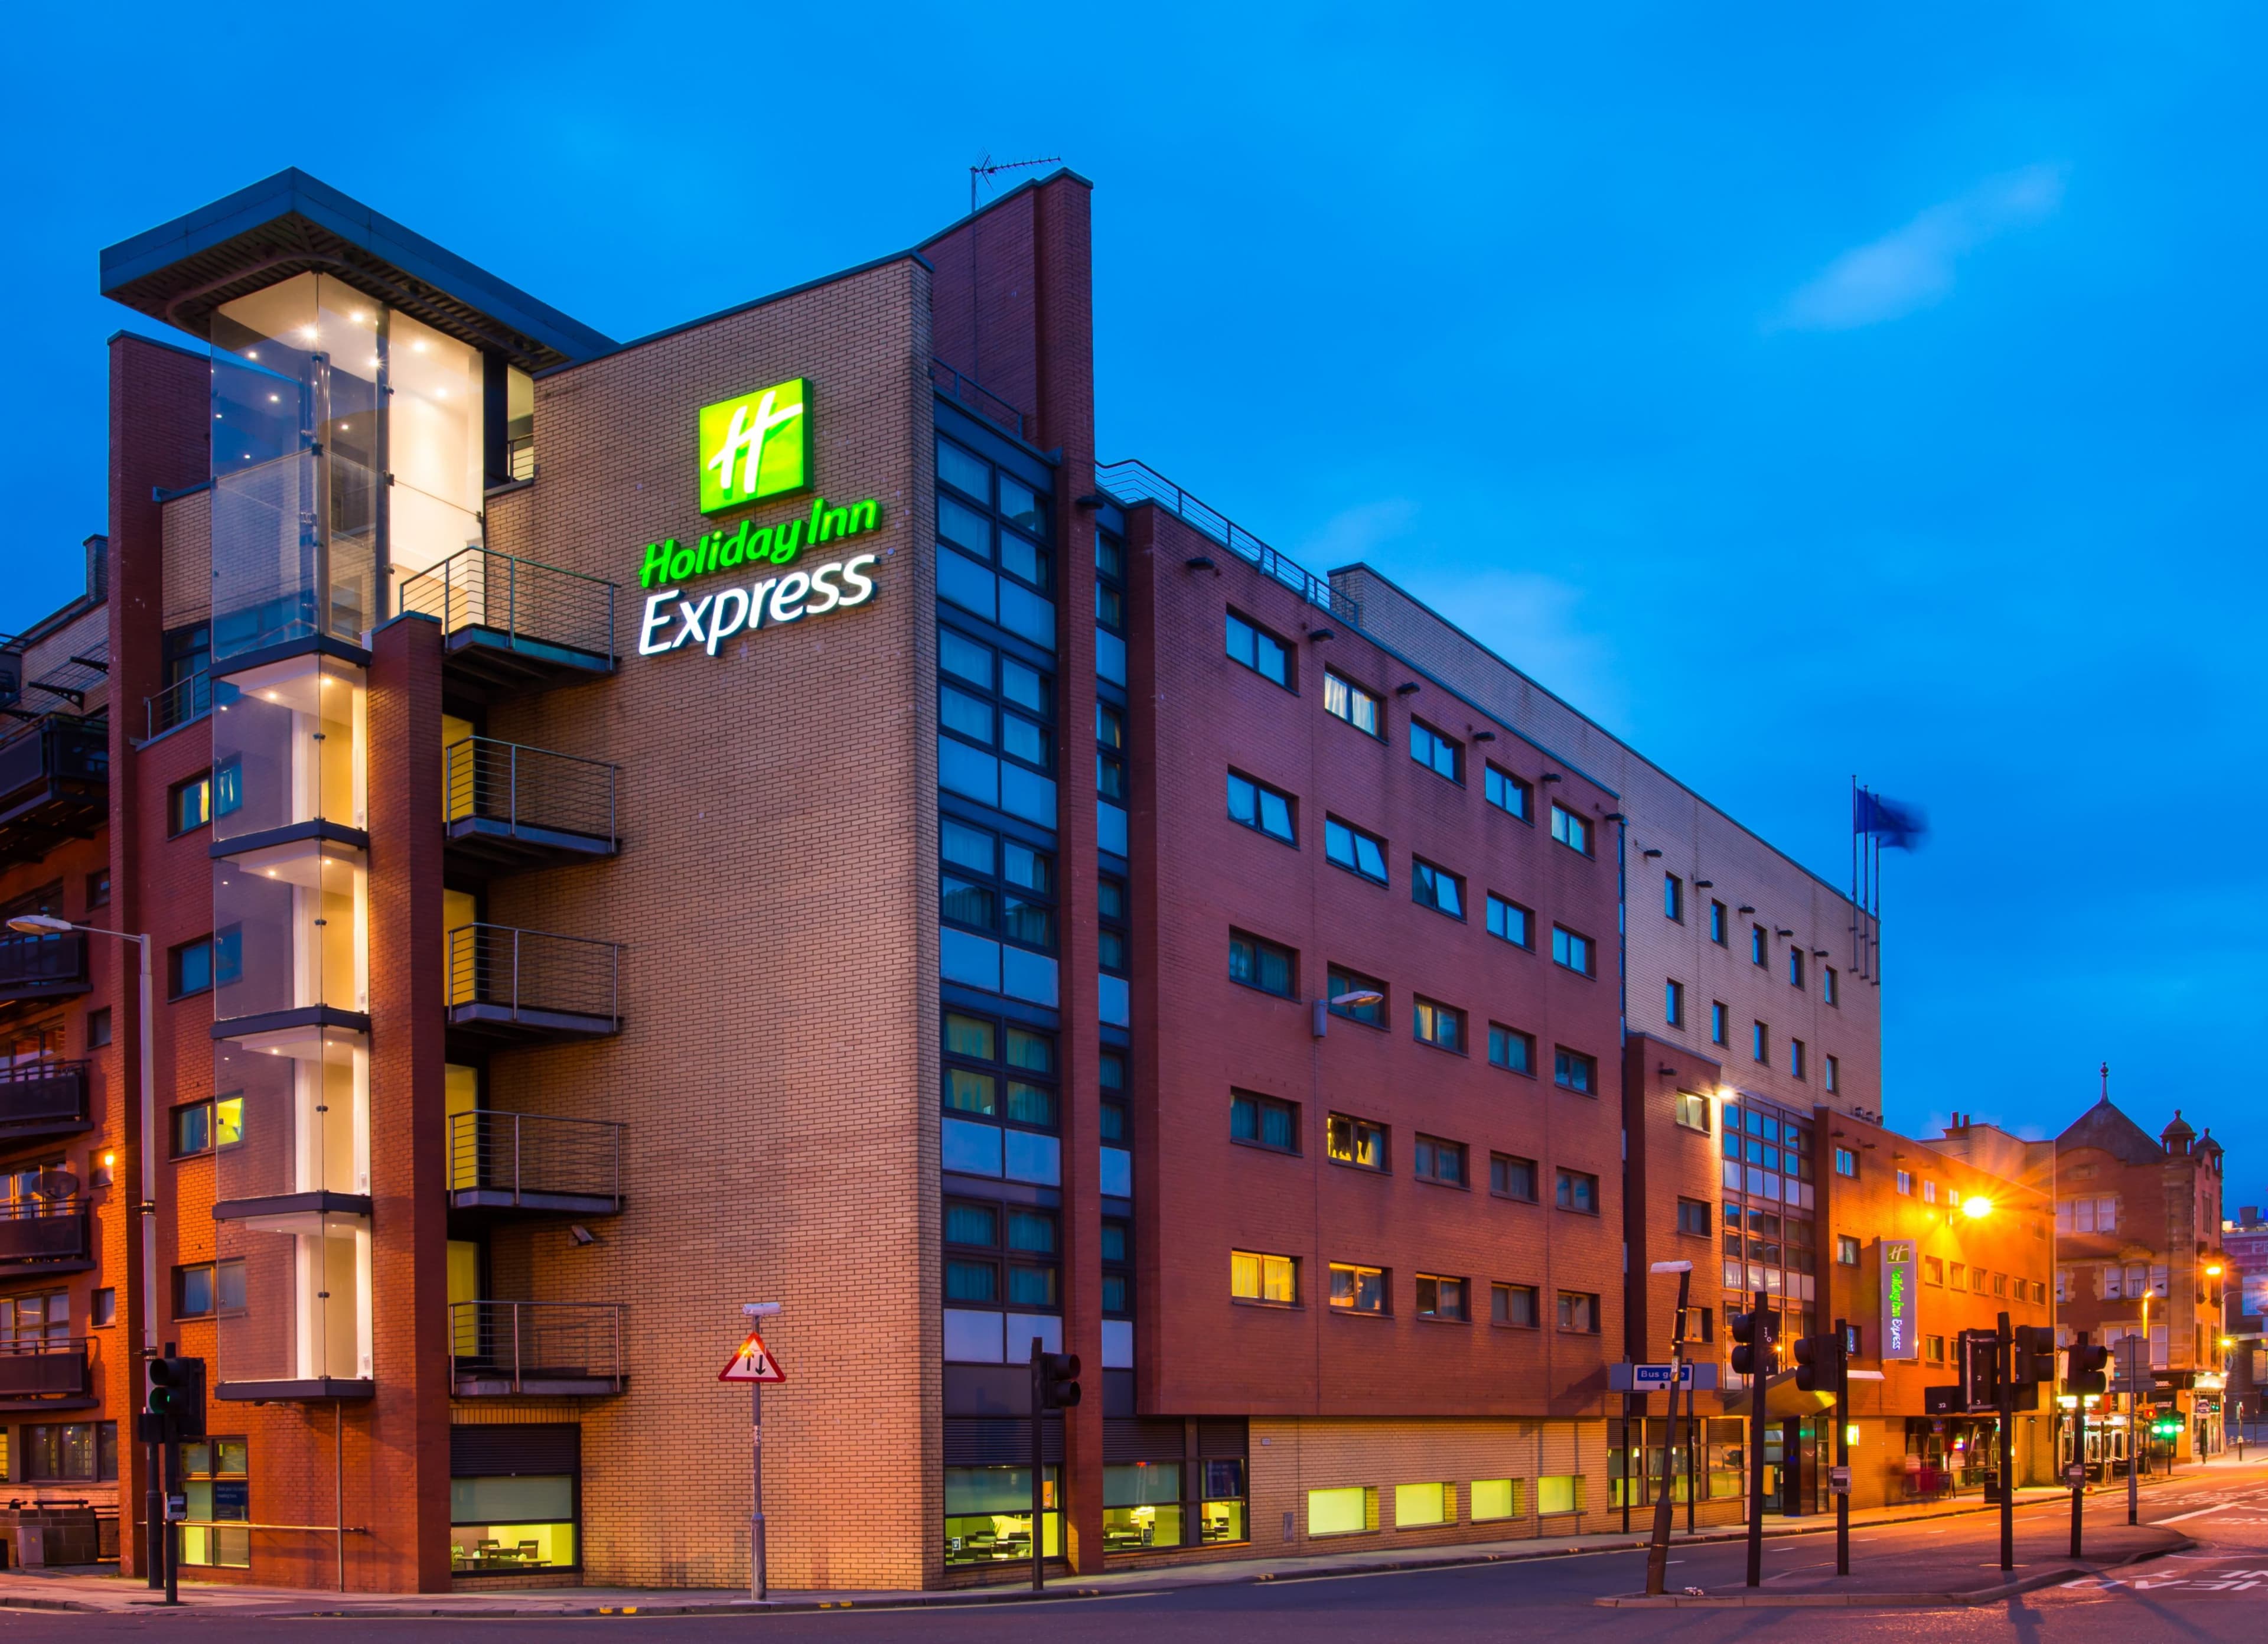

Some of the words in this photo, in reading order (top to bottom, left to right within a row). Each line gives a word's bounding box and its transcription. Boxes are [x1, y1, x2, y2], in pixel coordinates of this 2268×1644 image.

[708, 390, 803, 494] H
[639, 519, 806, 588] Holiday
[807, 498, 881, 545] Inn
[638, 554, 878, 656] Express
[1888, 1266, 1904, 1301] Holiday
[1891, 1319, 1902, 1350] Express
[1663, 1371, 1685, 1379] ge
